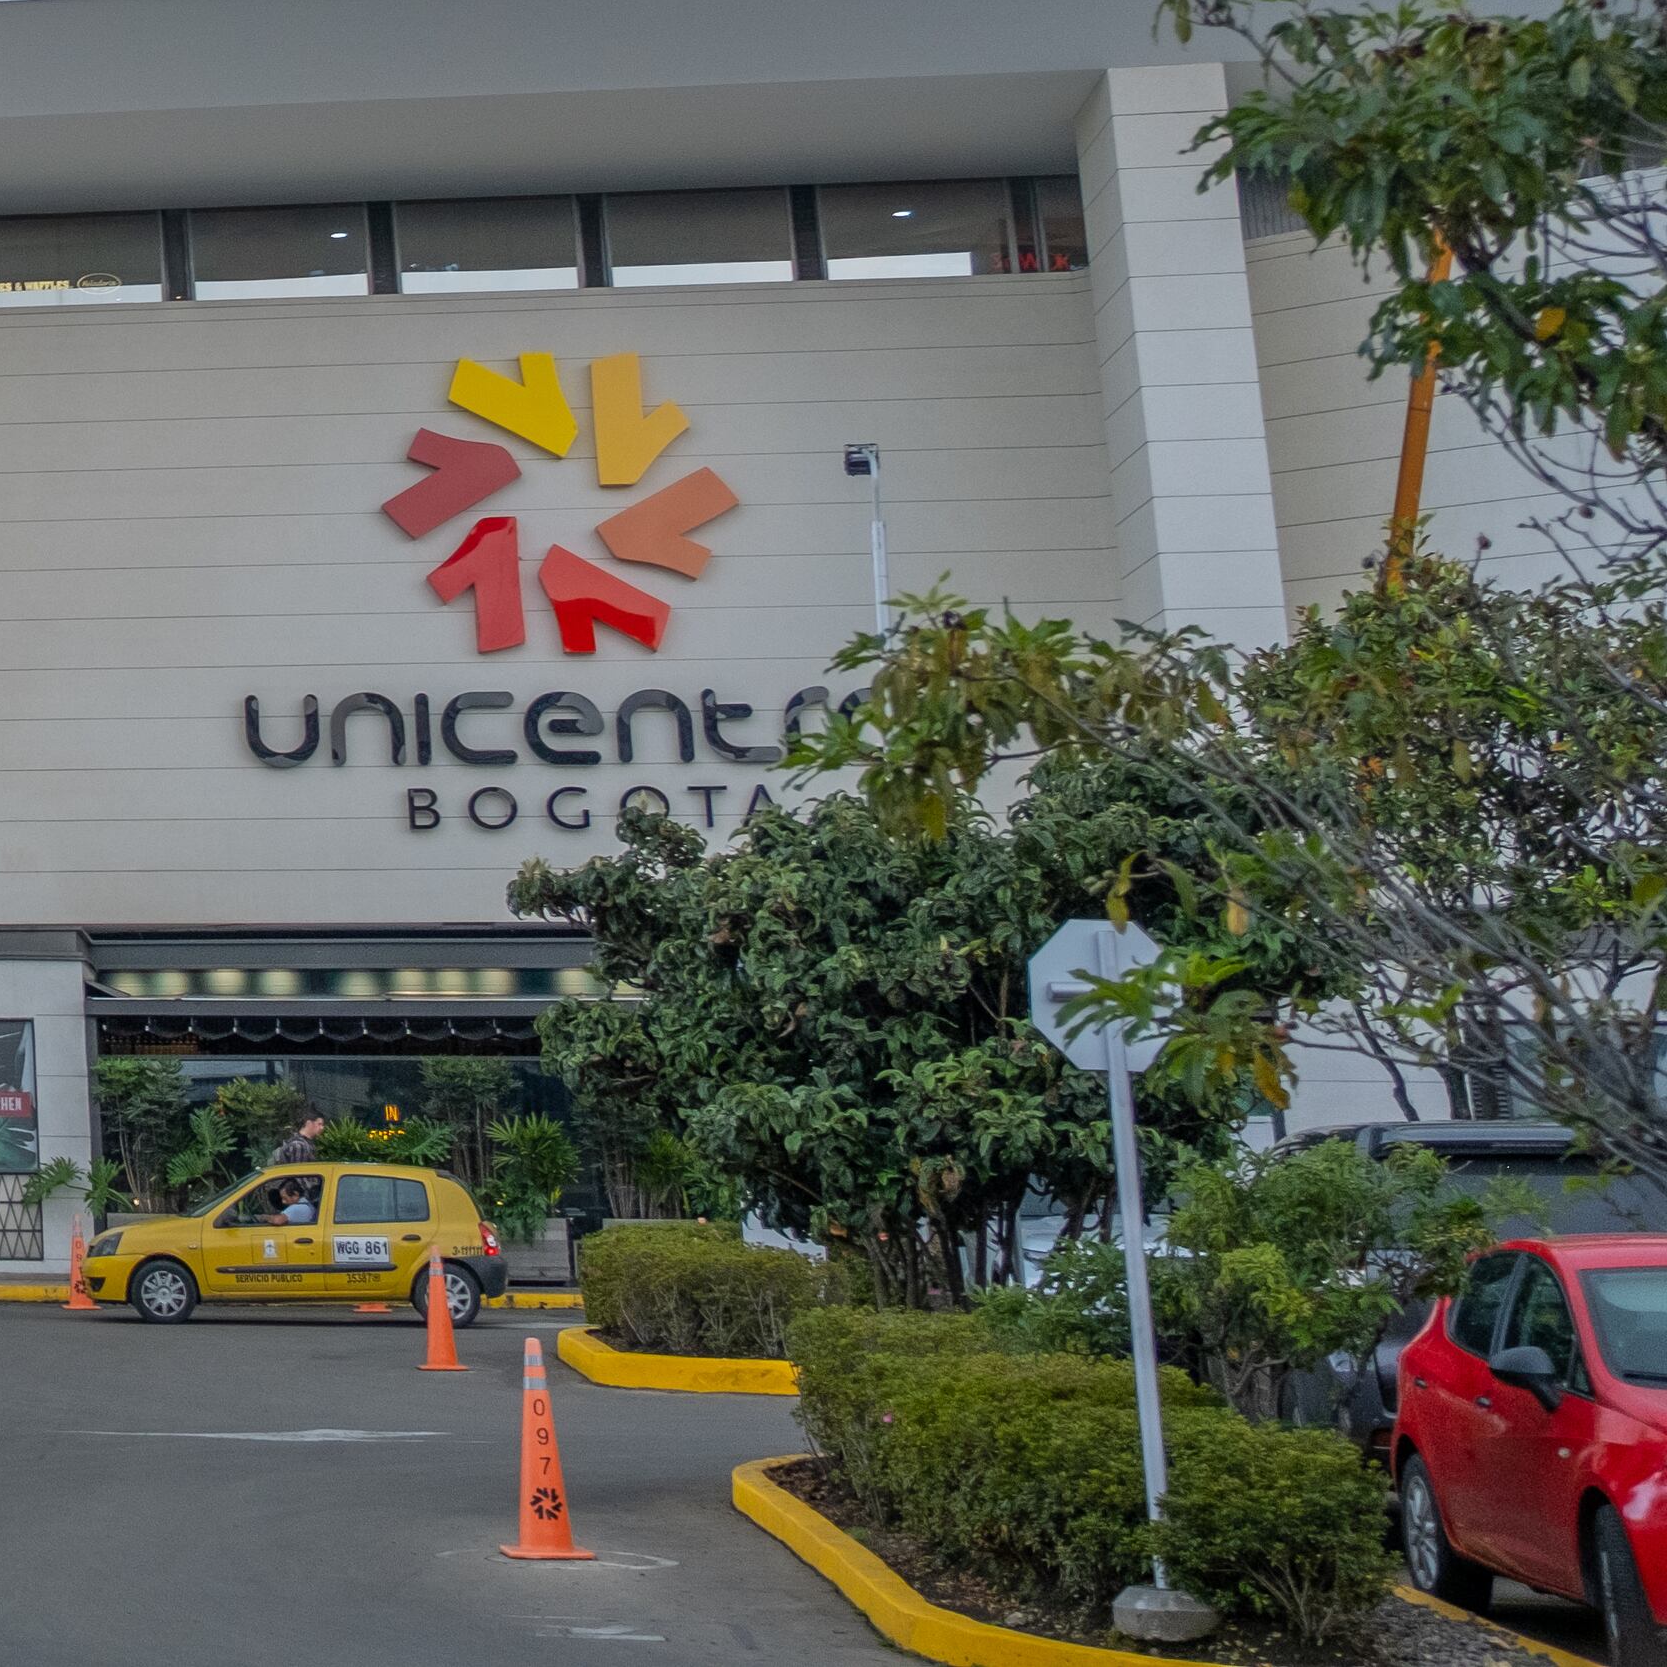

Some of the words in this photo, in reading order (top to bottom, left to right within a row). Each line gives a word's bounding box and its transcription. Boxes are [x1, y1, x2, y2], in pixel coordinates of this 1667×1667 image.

[336, 1240, 360, 1255] WGG
[364, 1240, 388, 1255] 861
[235, 1273, 269, 1283] SERVICIO
[533, 1398, 551, 1475] 097
